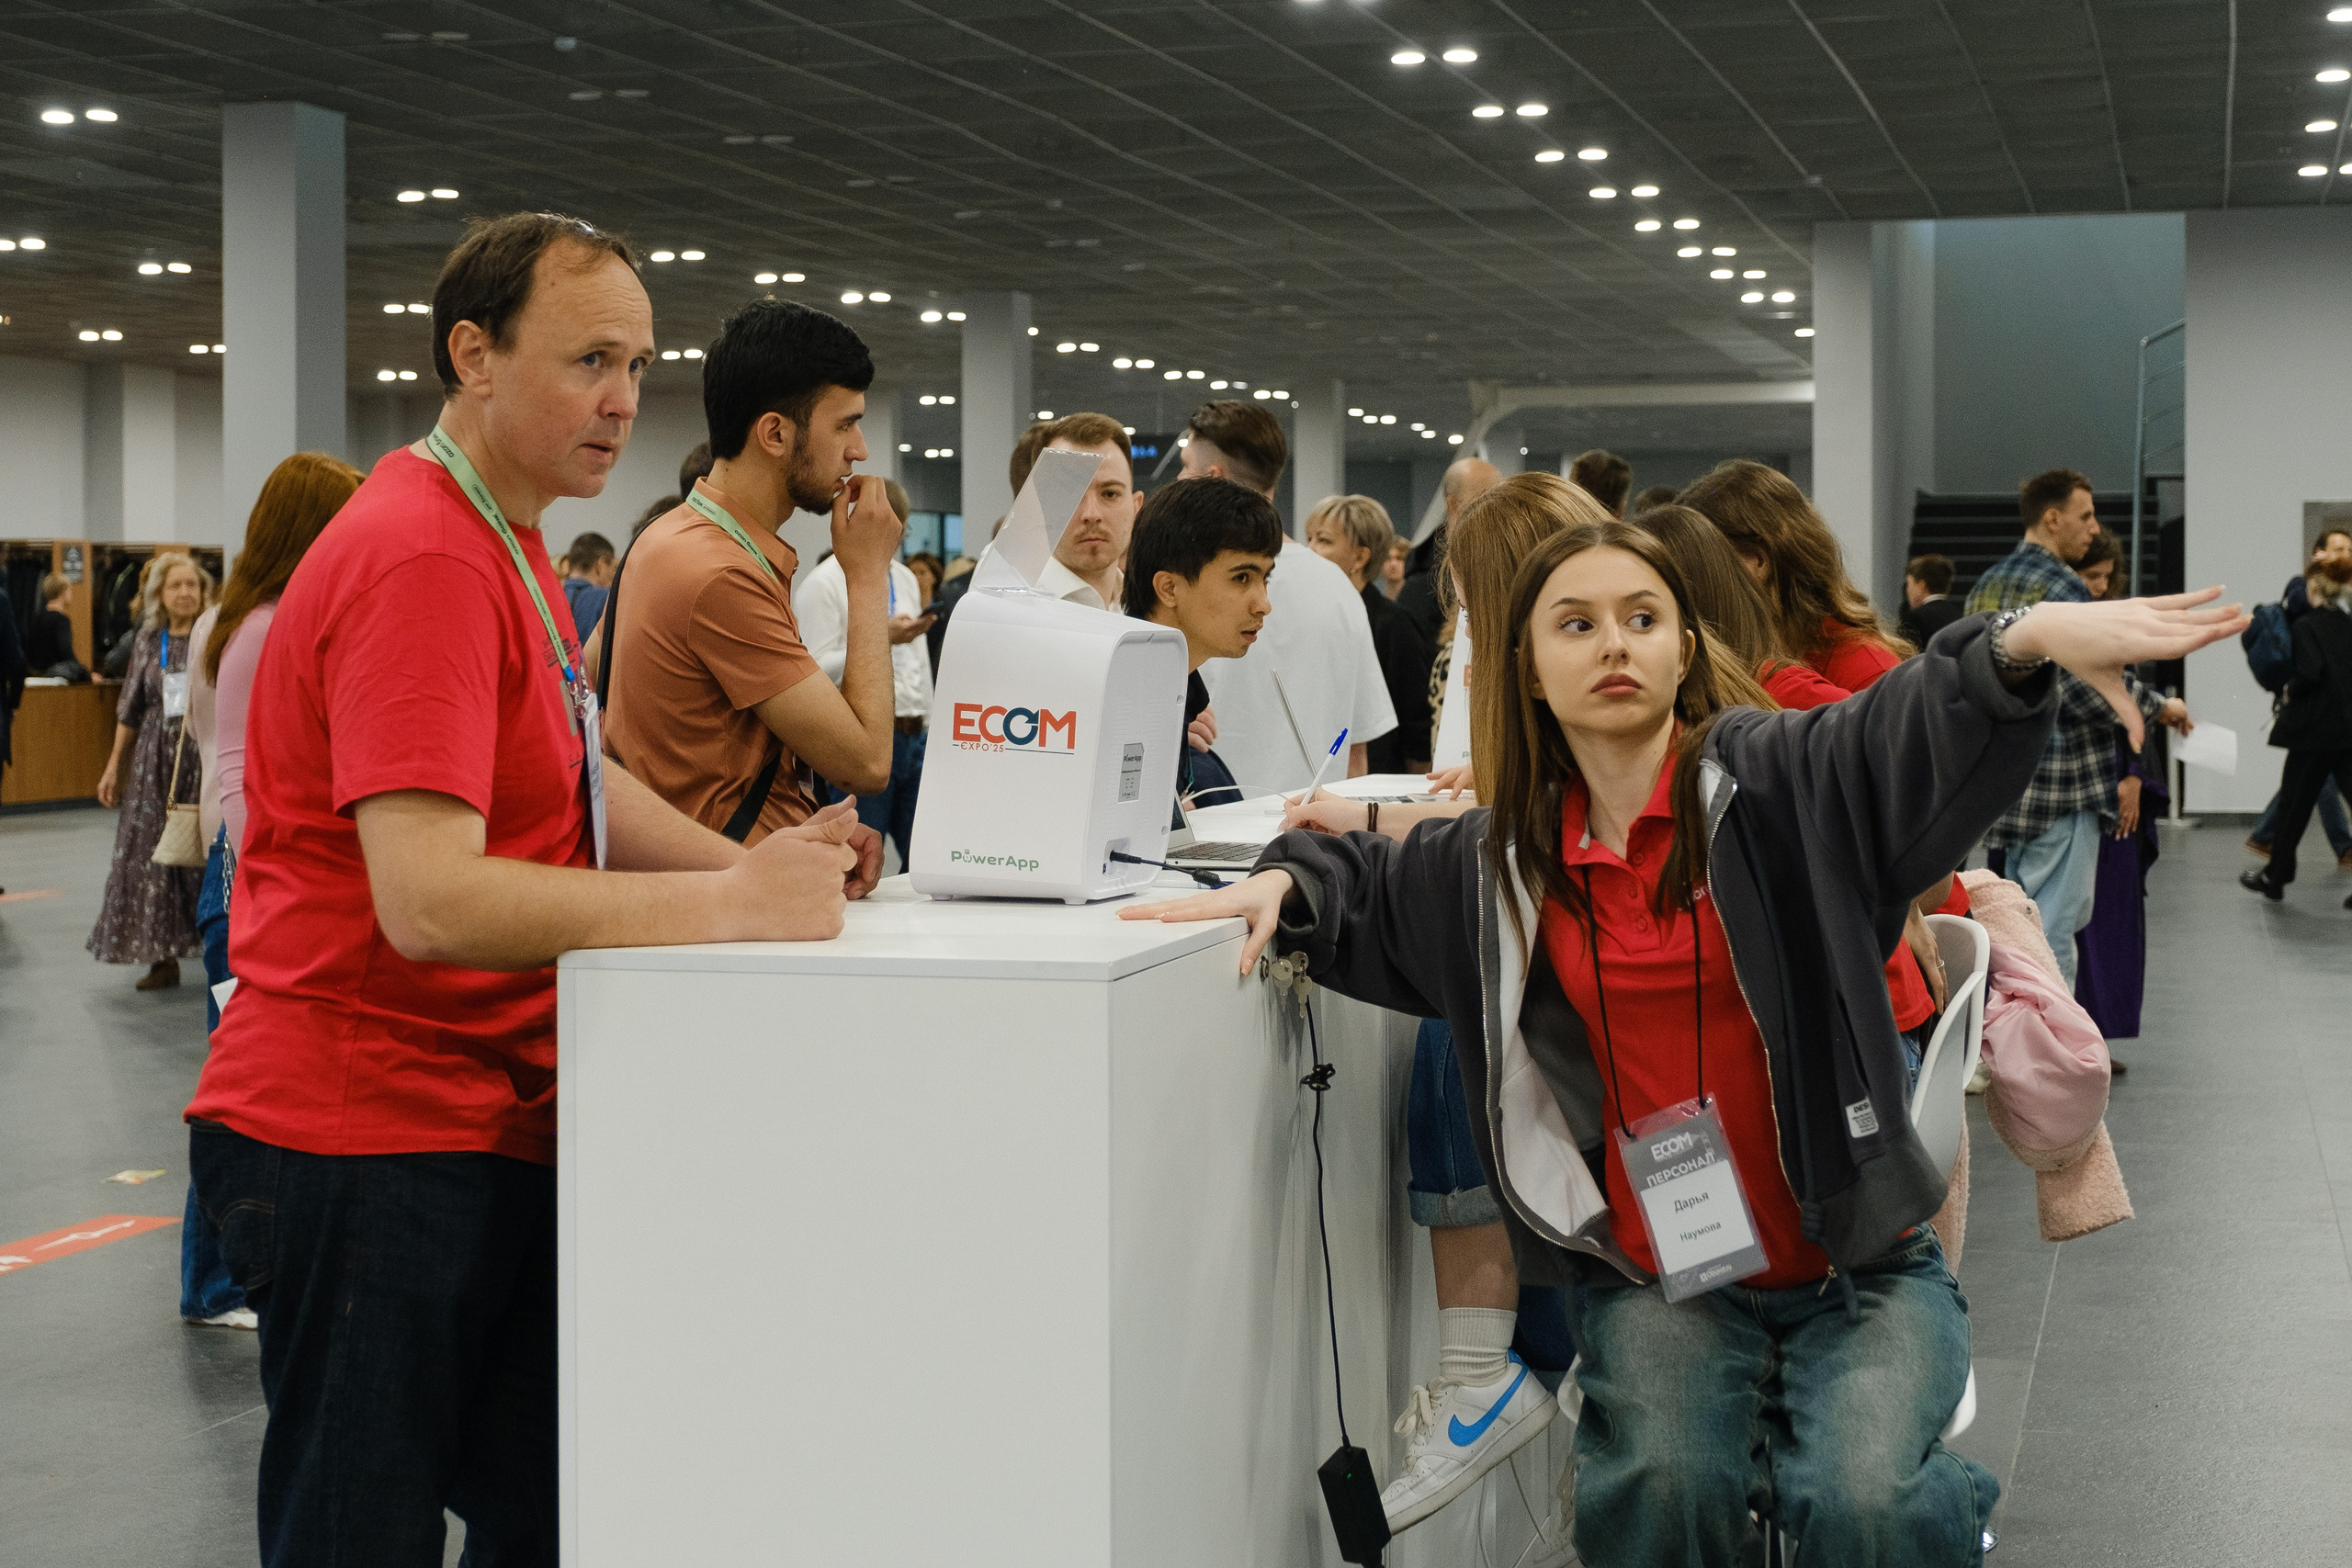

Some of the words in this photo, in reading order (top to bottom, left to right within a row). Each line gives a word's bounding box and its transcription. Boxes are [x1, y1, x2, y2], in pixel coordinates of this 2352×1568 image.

[734, 529, 747, 543] ozon
[953, 703, 1077, 750] ECOM
[960, 741, 1005, 753] EXPO'25
[951, 849, 1040, 871] PowerApp
[1650, 1131, 1694, 1160] ECOM
[1645, 1151, 1716, 1188] ПЕРСОНАЛ
[1673, 1191, 1710, 1213] Дарья
[1679, 1221, 1722, 1242] Наумова
